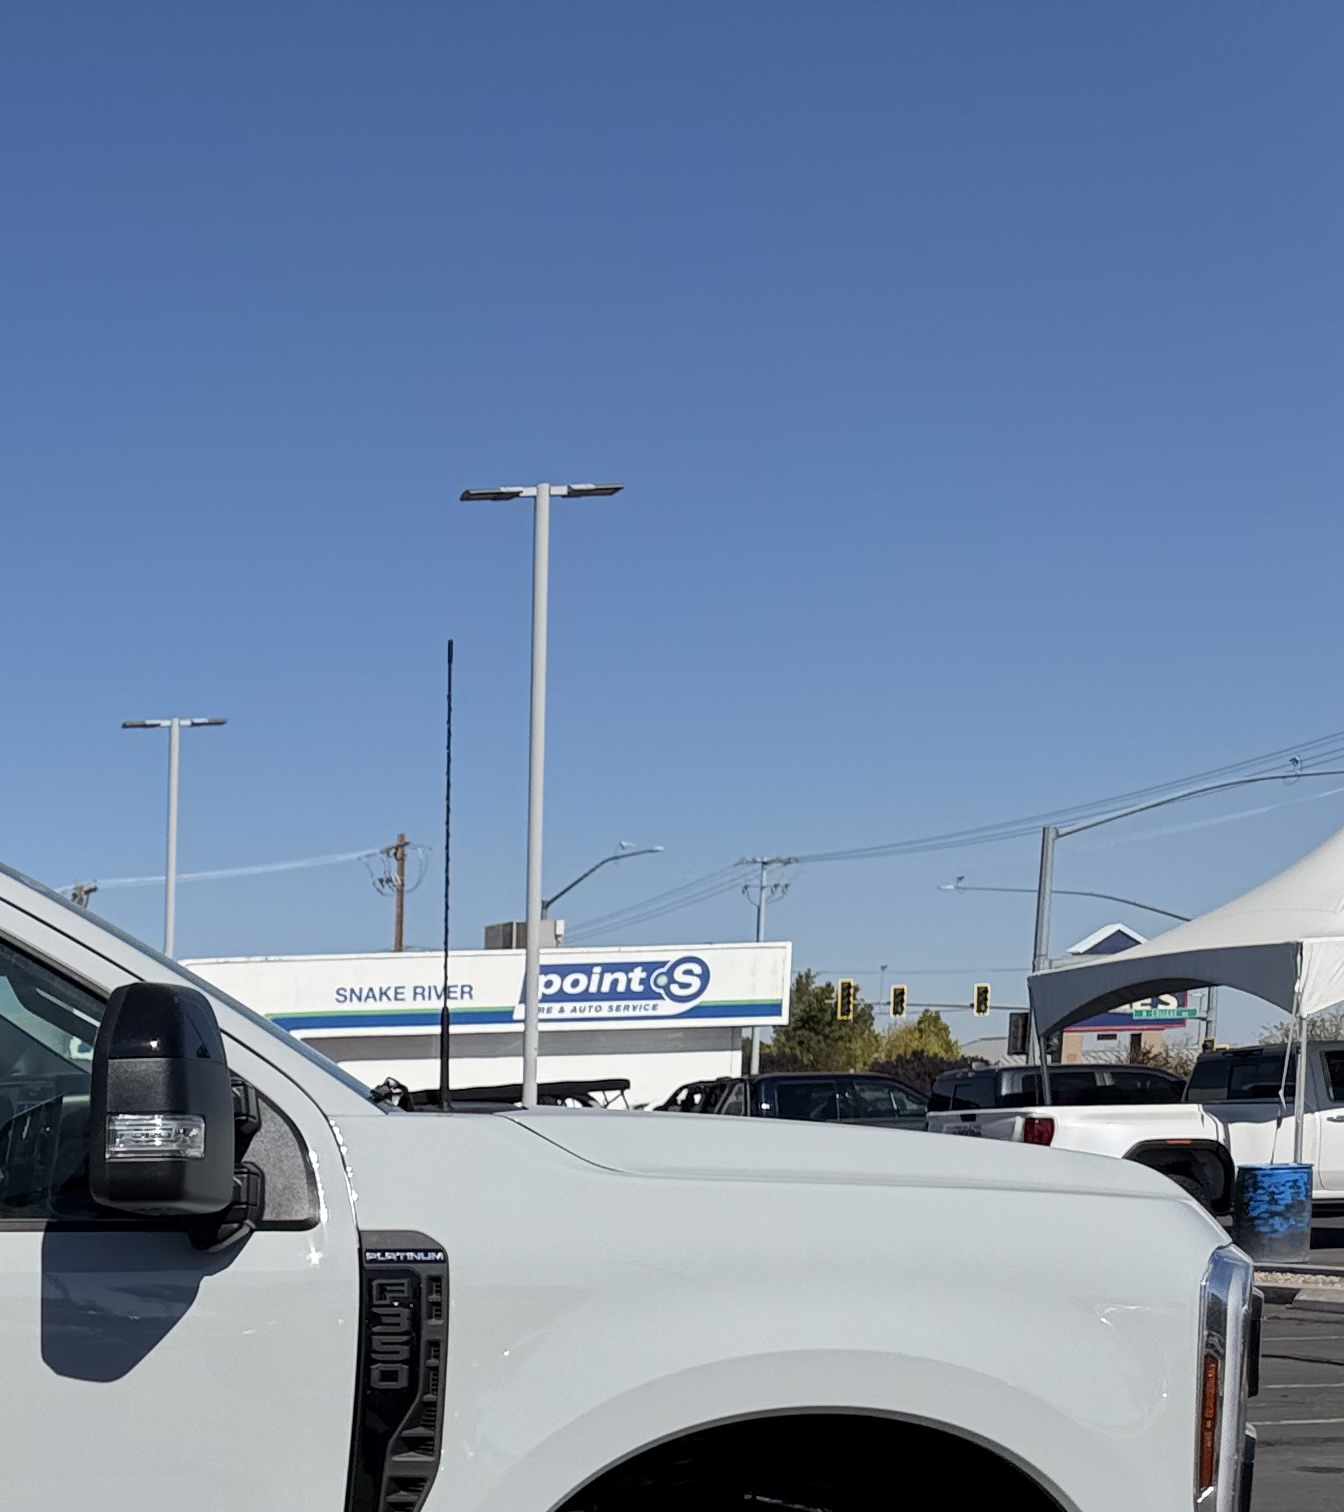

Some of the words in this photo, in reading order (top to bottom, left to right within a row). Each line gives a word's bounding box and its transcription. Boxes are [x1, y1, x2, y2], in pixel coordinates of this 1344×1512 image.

[538, 966, 647, 1000] point
[335, 985, 406, 1003] SNAKE
[413, 984, 474, 1001] RIVER
[570, 1004, 602, 1013] AUTO
[607, 1003, 659, 1012] SERVICE
[365, 1251, 444, 1261] PLATINUM
